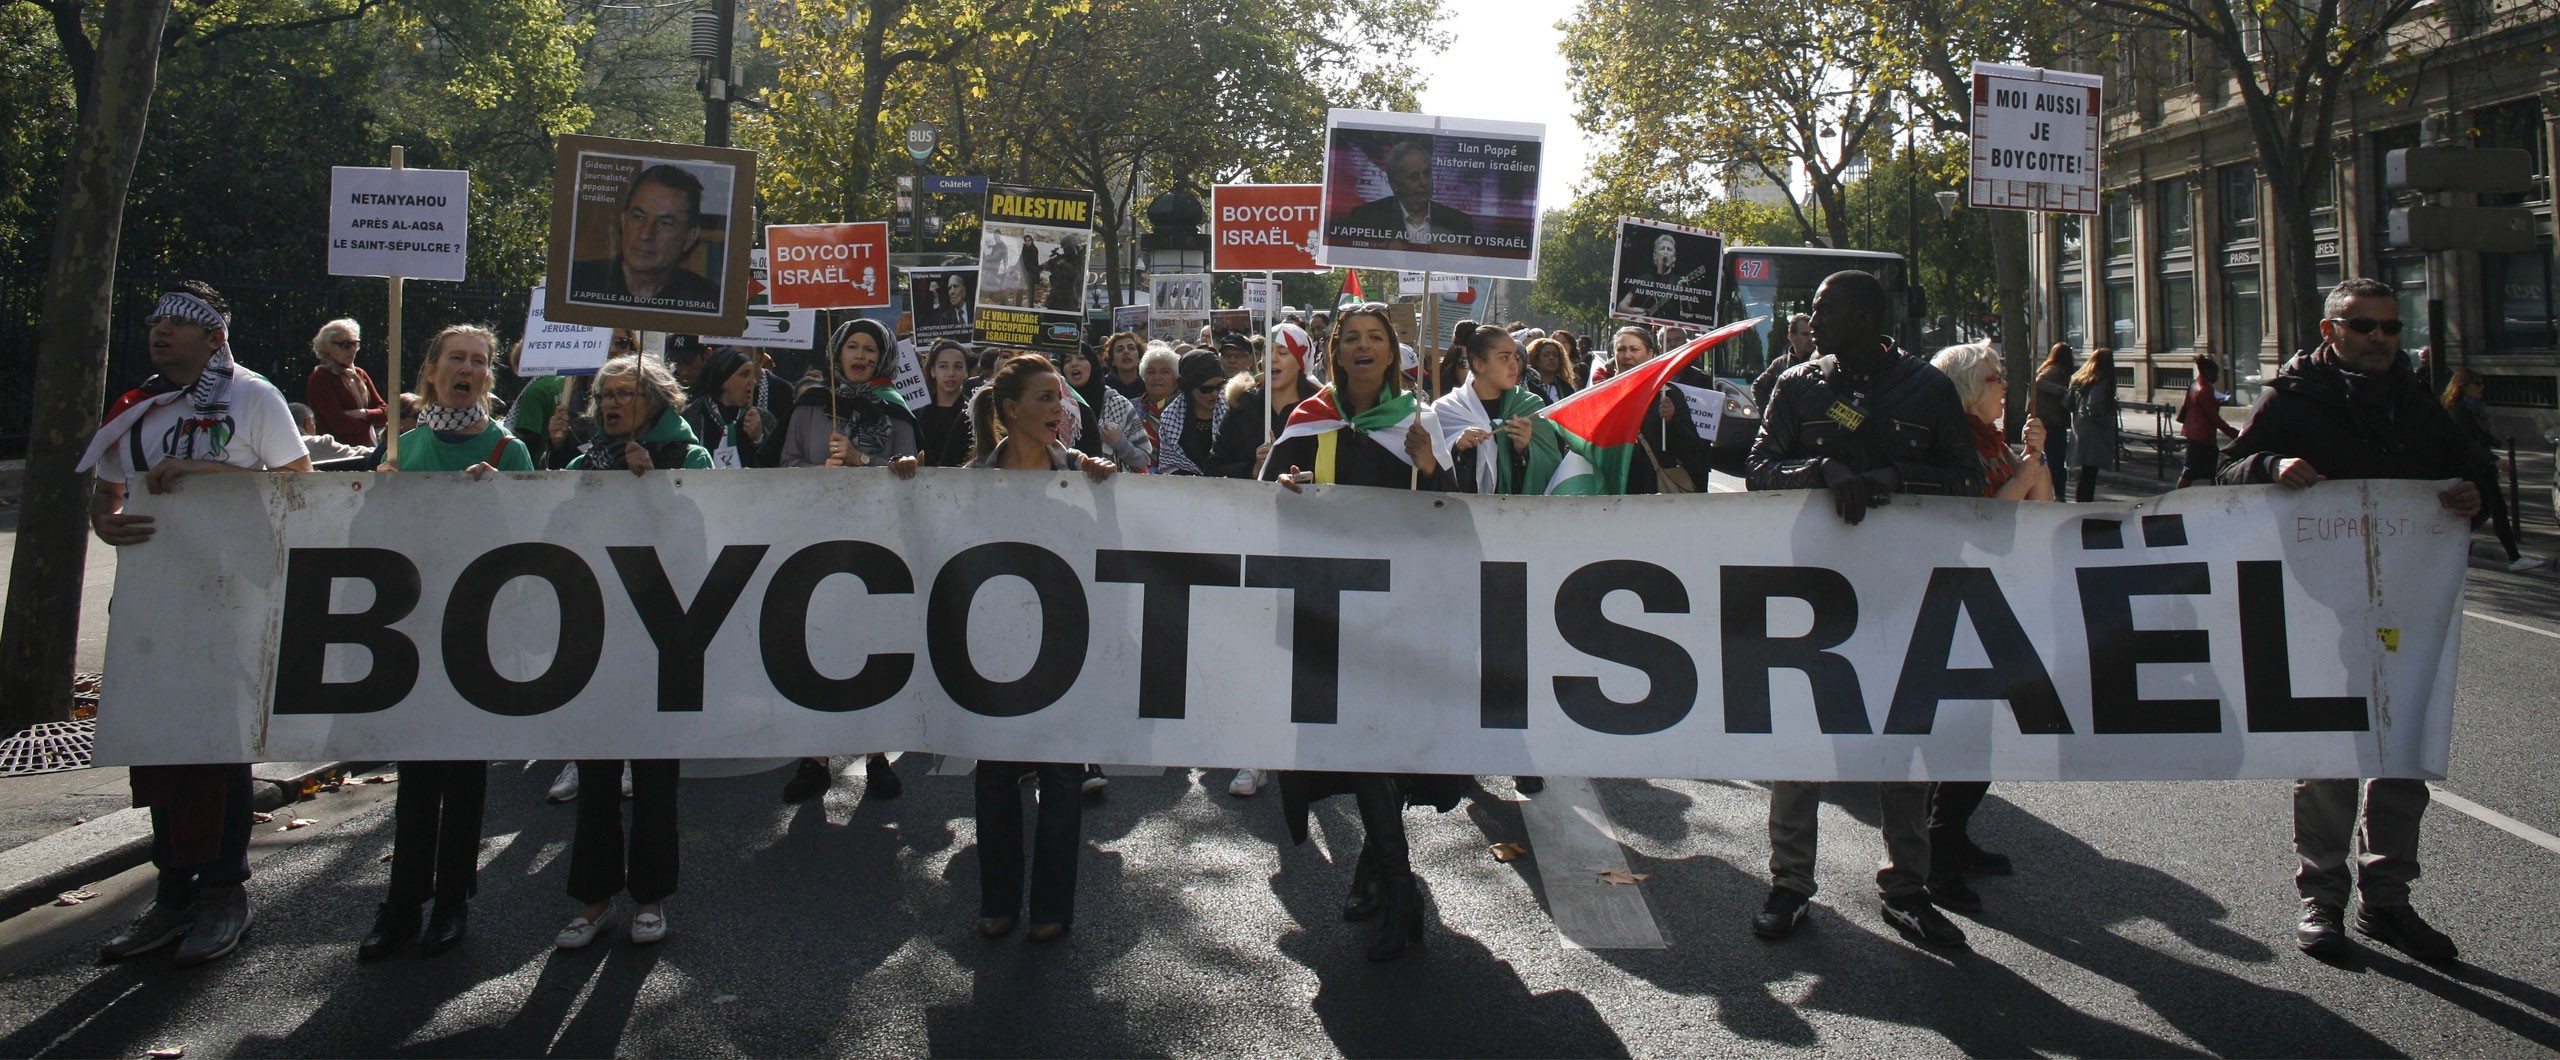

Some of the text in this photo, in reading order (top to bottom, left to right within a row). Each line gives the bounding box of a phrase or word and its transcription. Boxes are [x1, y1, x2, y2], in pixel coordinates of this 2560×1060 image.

[1996, 89, 2080, 115] MOI AUSSI
[909, 130, 933, 142] BUS
[2030, 122, 2050, 141] JE
[1457, 142, 1517, 158] Ilan Pappé
[585, 160, 635, 174] Gideon Levy
[1436, 156, 1536, 173] historien israélien
[1991, 148, 2082, 174] BOYCOTTE!
[582, 183, 619, 193] opposant
[939, 180, 972, 188] Châtelet
[351, 193, 447, 207] NETANYAHOU
[991, 194, 1087, 222] PALESTINE
[1222, 206, 1318, 222] BOYCOTT
[351, 218, 444, 231] APRÈS AL-AQSA
[1222, 226, 1294, 245] ISRAËL
[1330, 225, 1528, 249] J'APPELLE AU BOYCOTT D'ISRAËL
[333, 239, 460, 253] LE SAINT-SÉPULCRE ?
[777, 243, 873, 262] BOYCOTT
[2230, 251, 2250, 264] PARIS
[778, 265, 850, 285] ISRAËL
[1739, 260, 1762, 278] 47
[1624, 277, 1713, 297] J'APPELLE TOUS LES ARTISTES
[1645, 289, 1673, 299] BOYCOTT
[572, 290, 717, 310] J'APPELLE AU BOYCOTT D'ISRAËL
[982, 310, 1039, 325] LE VRAI VISAGE
[975, 319, 985, 329] DE
[986, 320, 1040, 335] L'OCCUPATION
[528, 341, 552, 349] N'EST
[554, 341, 572, 349] PAS
[582, 341, 597, 349] TOI
[598, 341, 602, 349] !
[897, 363, 912, 374] LE
[895, 375, 921, 390] OINE
[1690, 409, 1714, 418] EXION
[1695, 422, 1711, 430] LEM
[273, 514, 2369, 735] BOYCOTT ISRAËL
